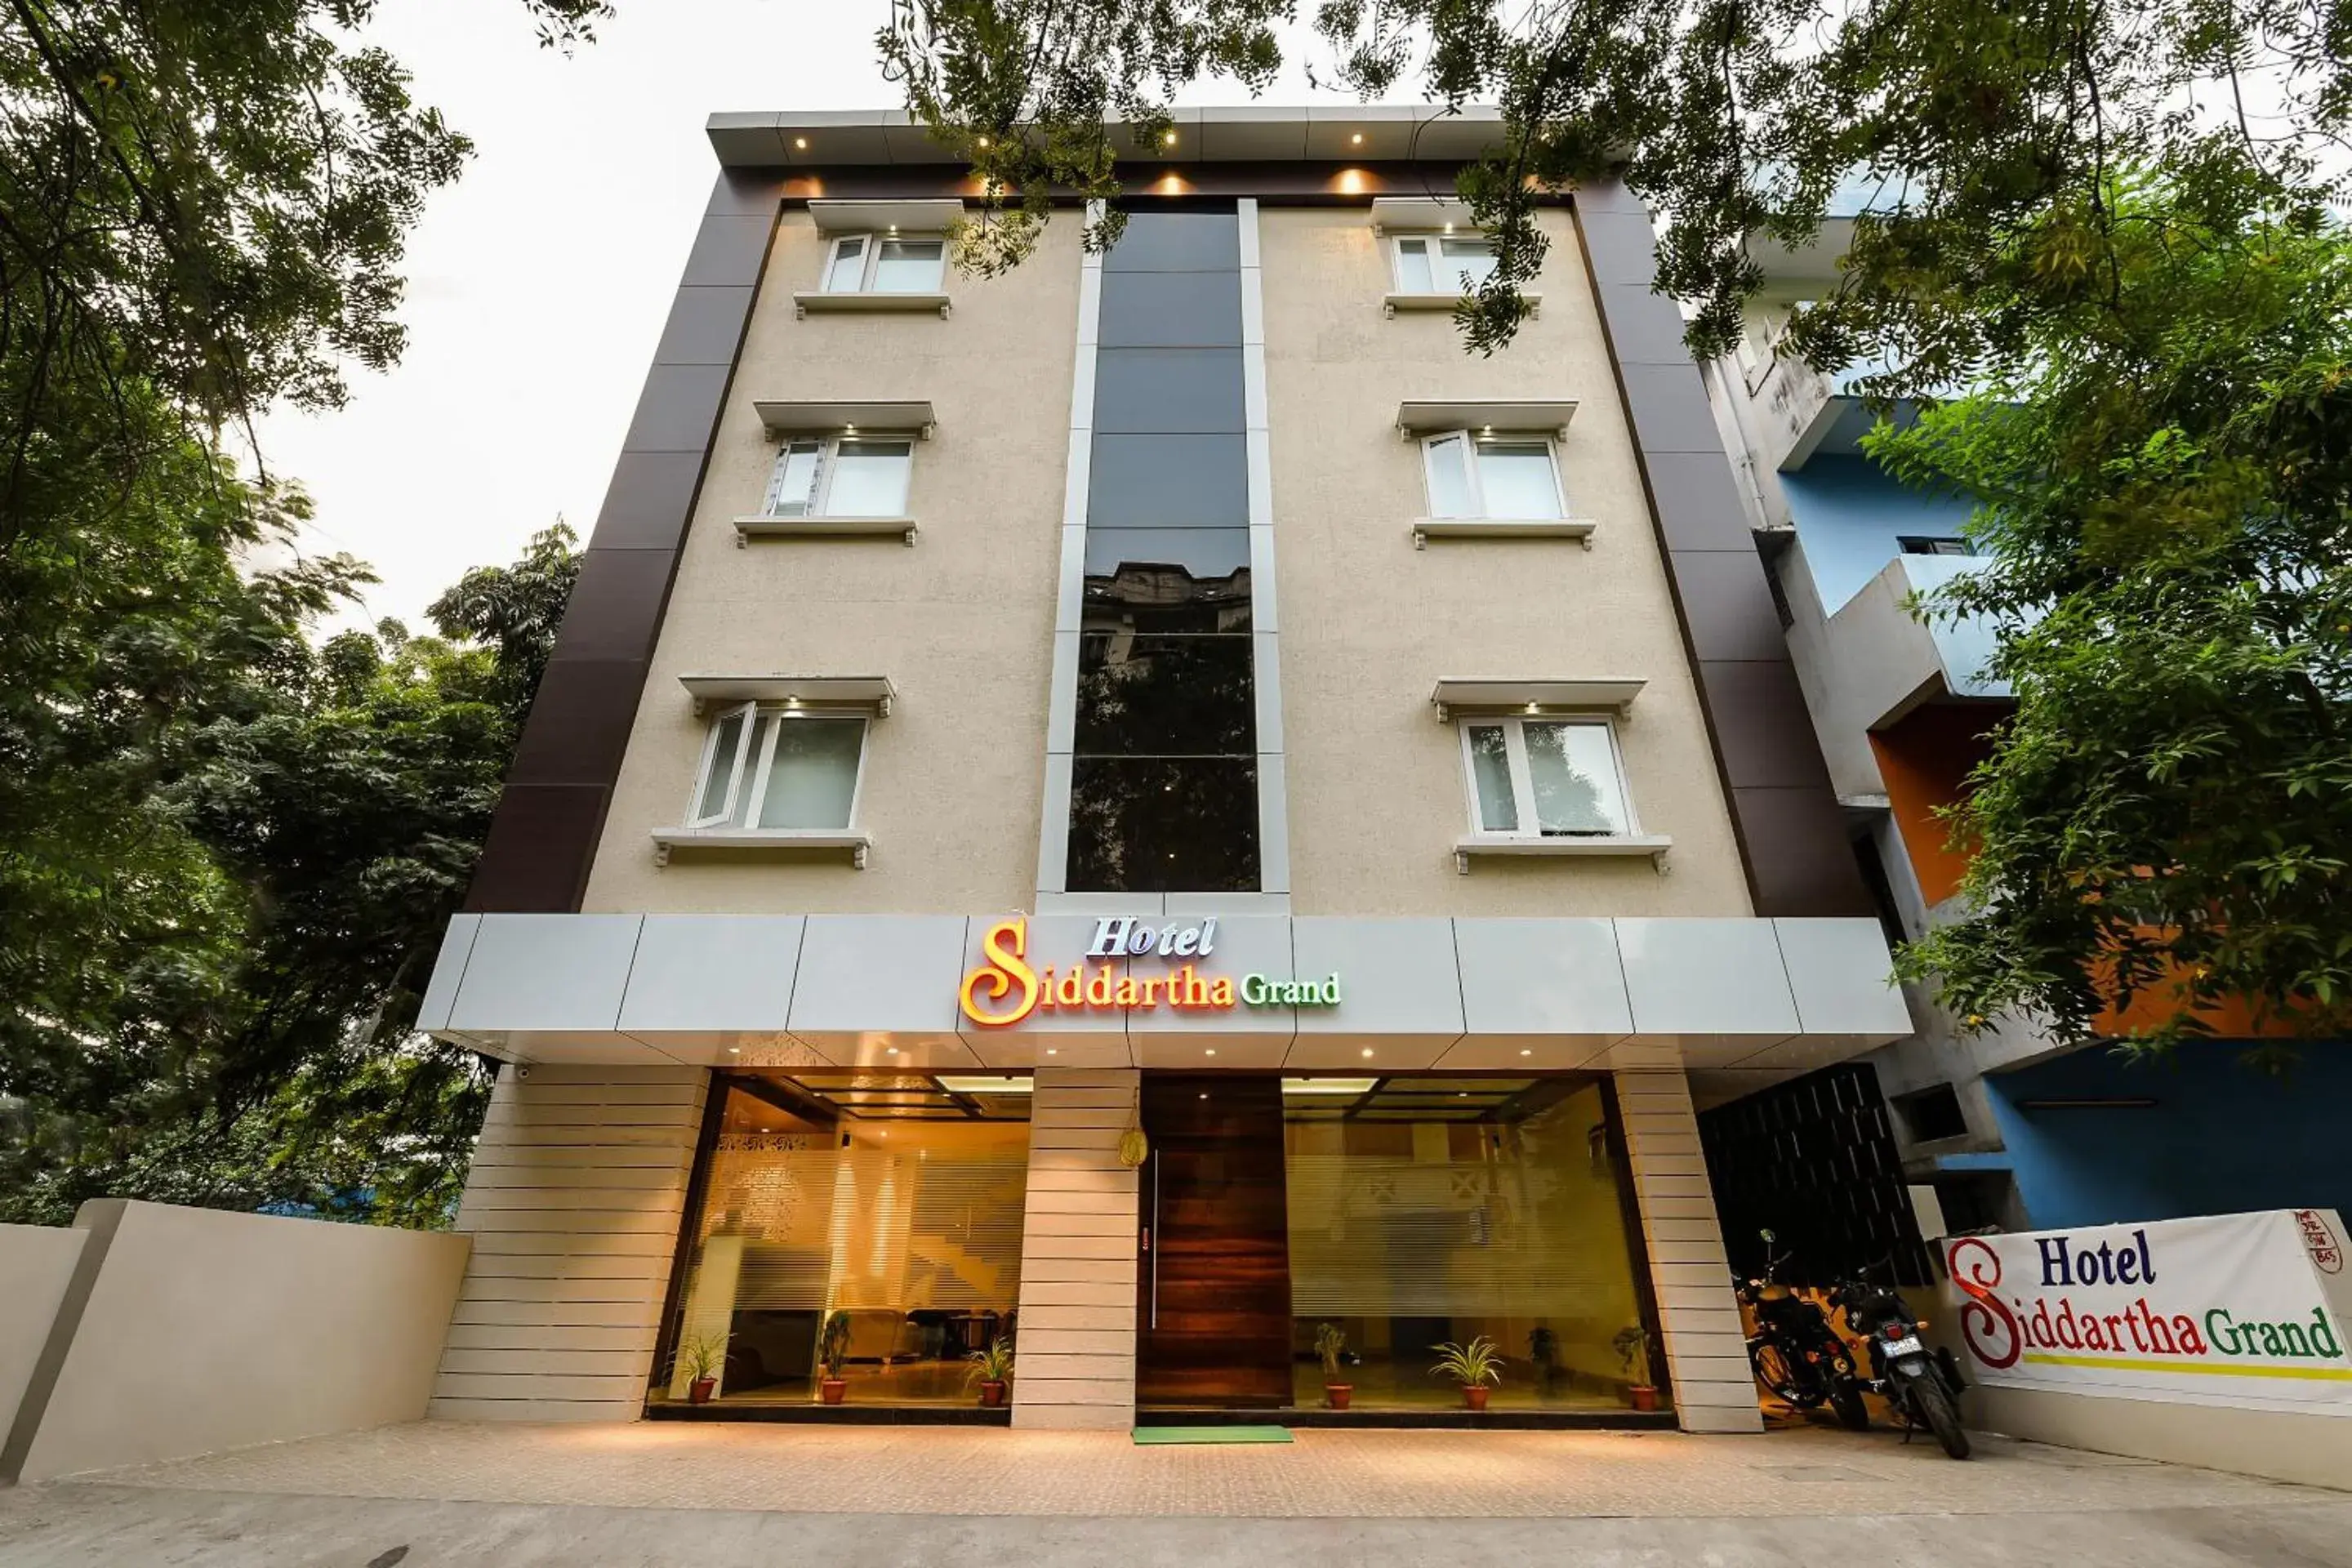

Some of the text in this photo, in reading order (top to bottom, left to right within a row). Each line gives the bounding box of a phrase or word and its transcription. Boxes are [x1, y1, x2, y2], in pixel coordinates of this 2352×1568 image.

[960, 916, 1342, 1027] Siddartha Grand
[1086, 916, 1218, 960] Hotel
[2035, 1230, 2156, 1287] Hotel
[1949, 1238, 2343, 1370] Siddartha Grand
